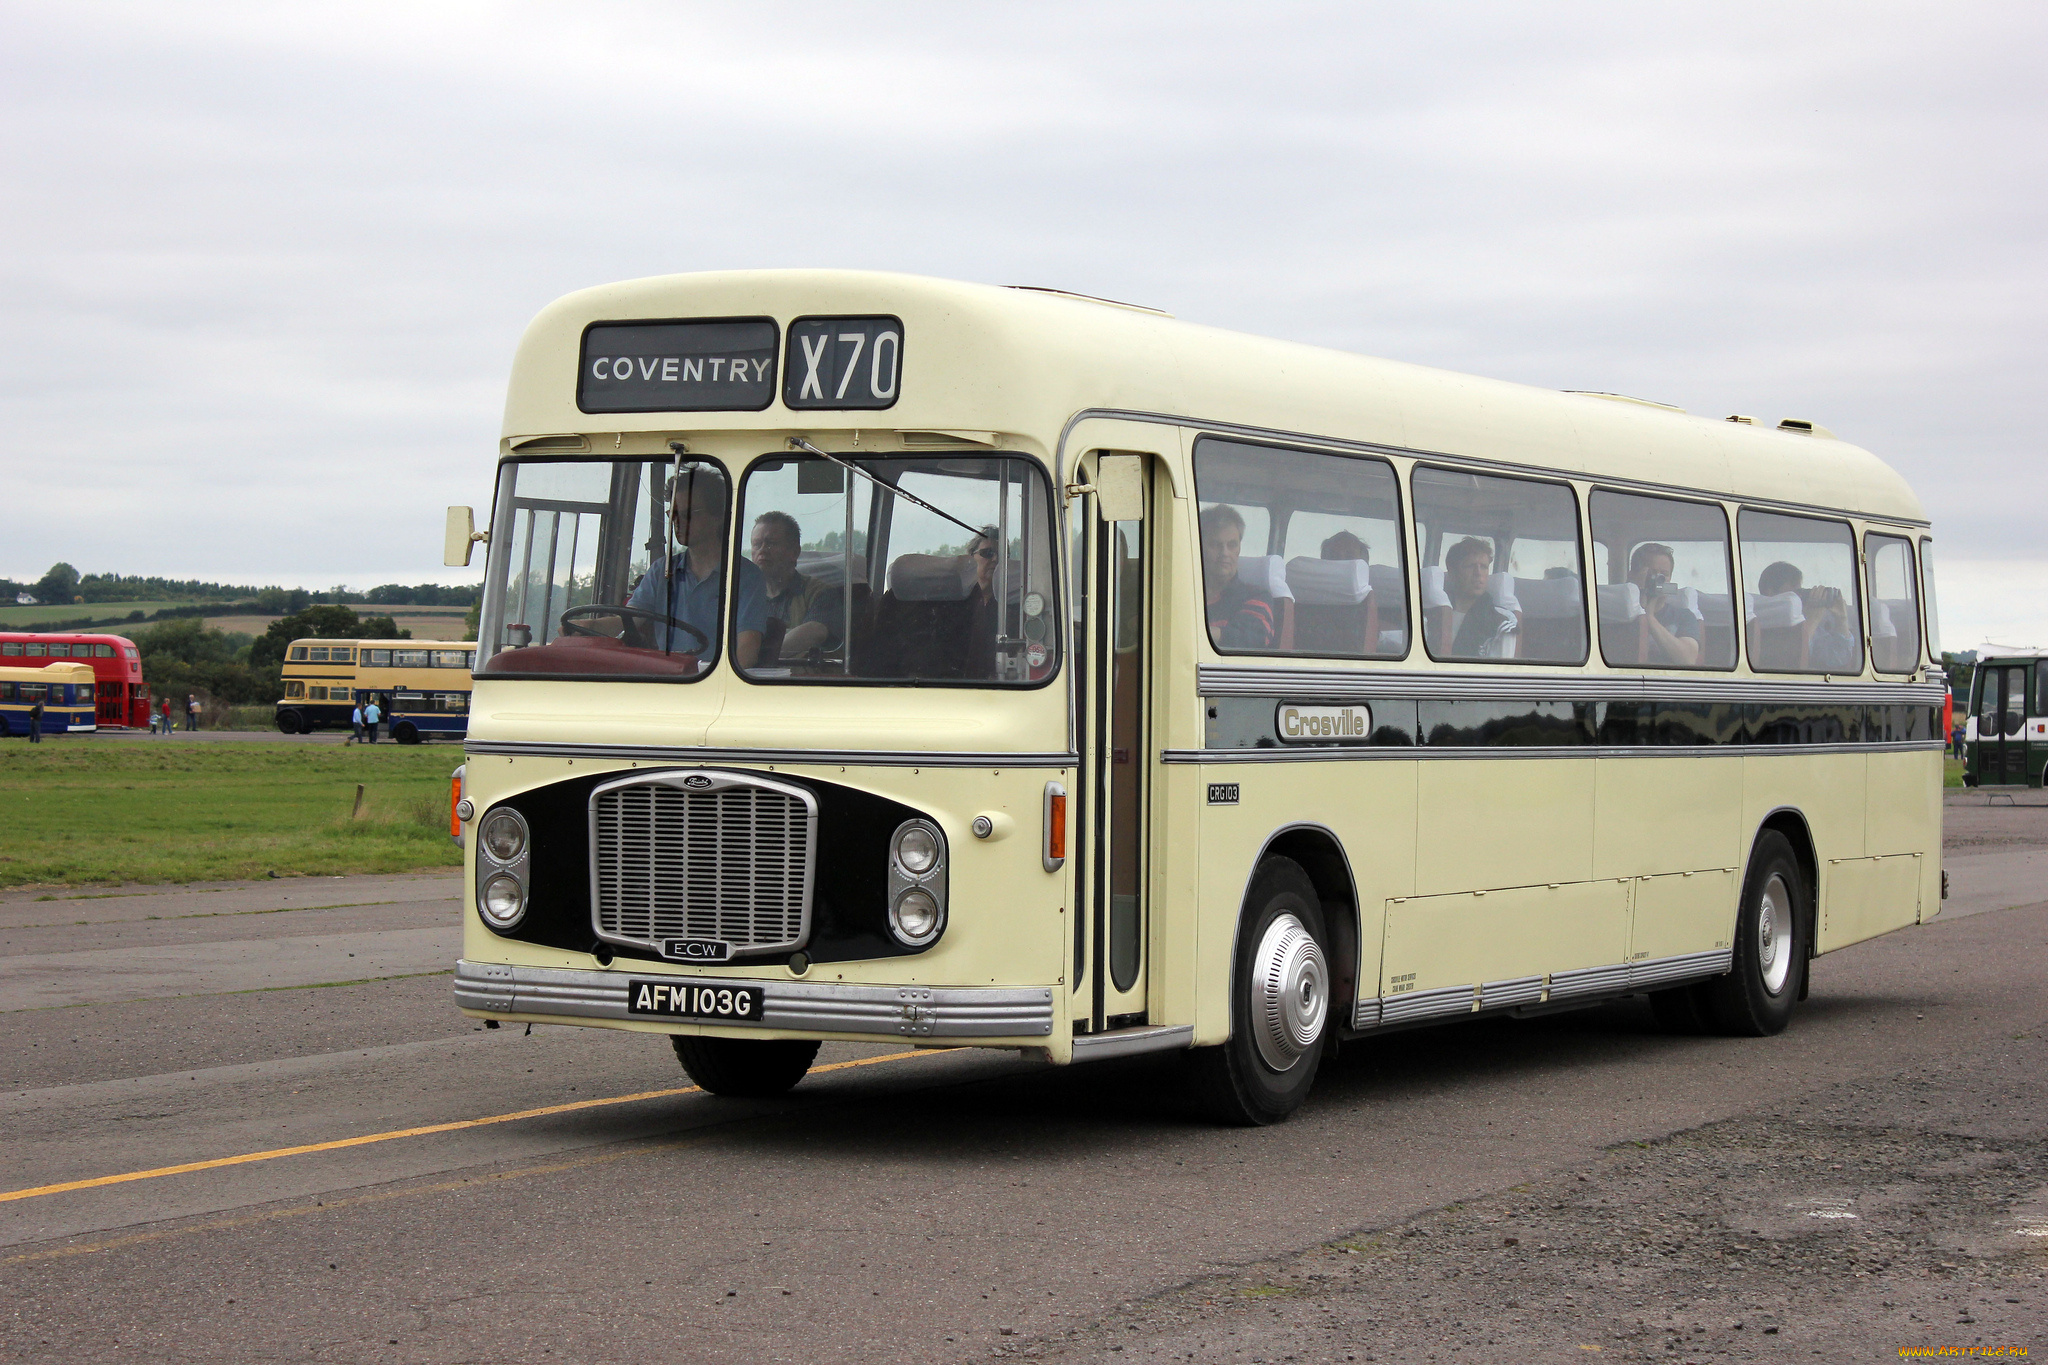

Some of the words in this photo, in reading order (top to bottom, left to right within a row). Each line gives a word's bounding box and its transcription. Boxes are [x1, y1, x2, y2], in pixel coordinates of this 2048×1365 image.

[592, 357, 771, 382] COVENTRY
[800, 331, 898, 400] X70
[1285, 709, 1363, 736] Crosville
[1209, 786, 1237, 800] CRG103
[674, 943, 716, 956] ECW
